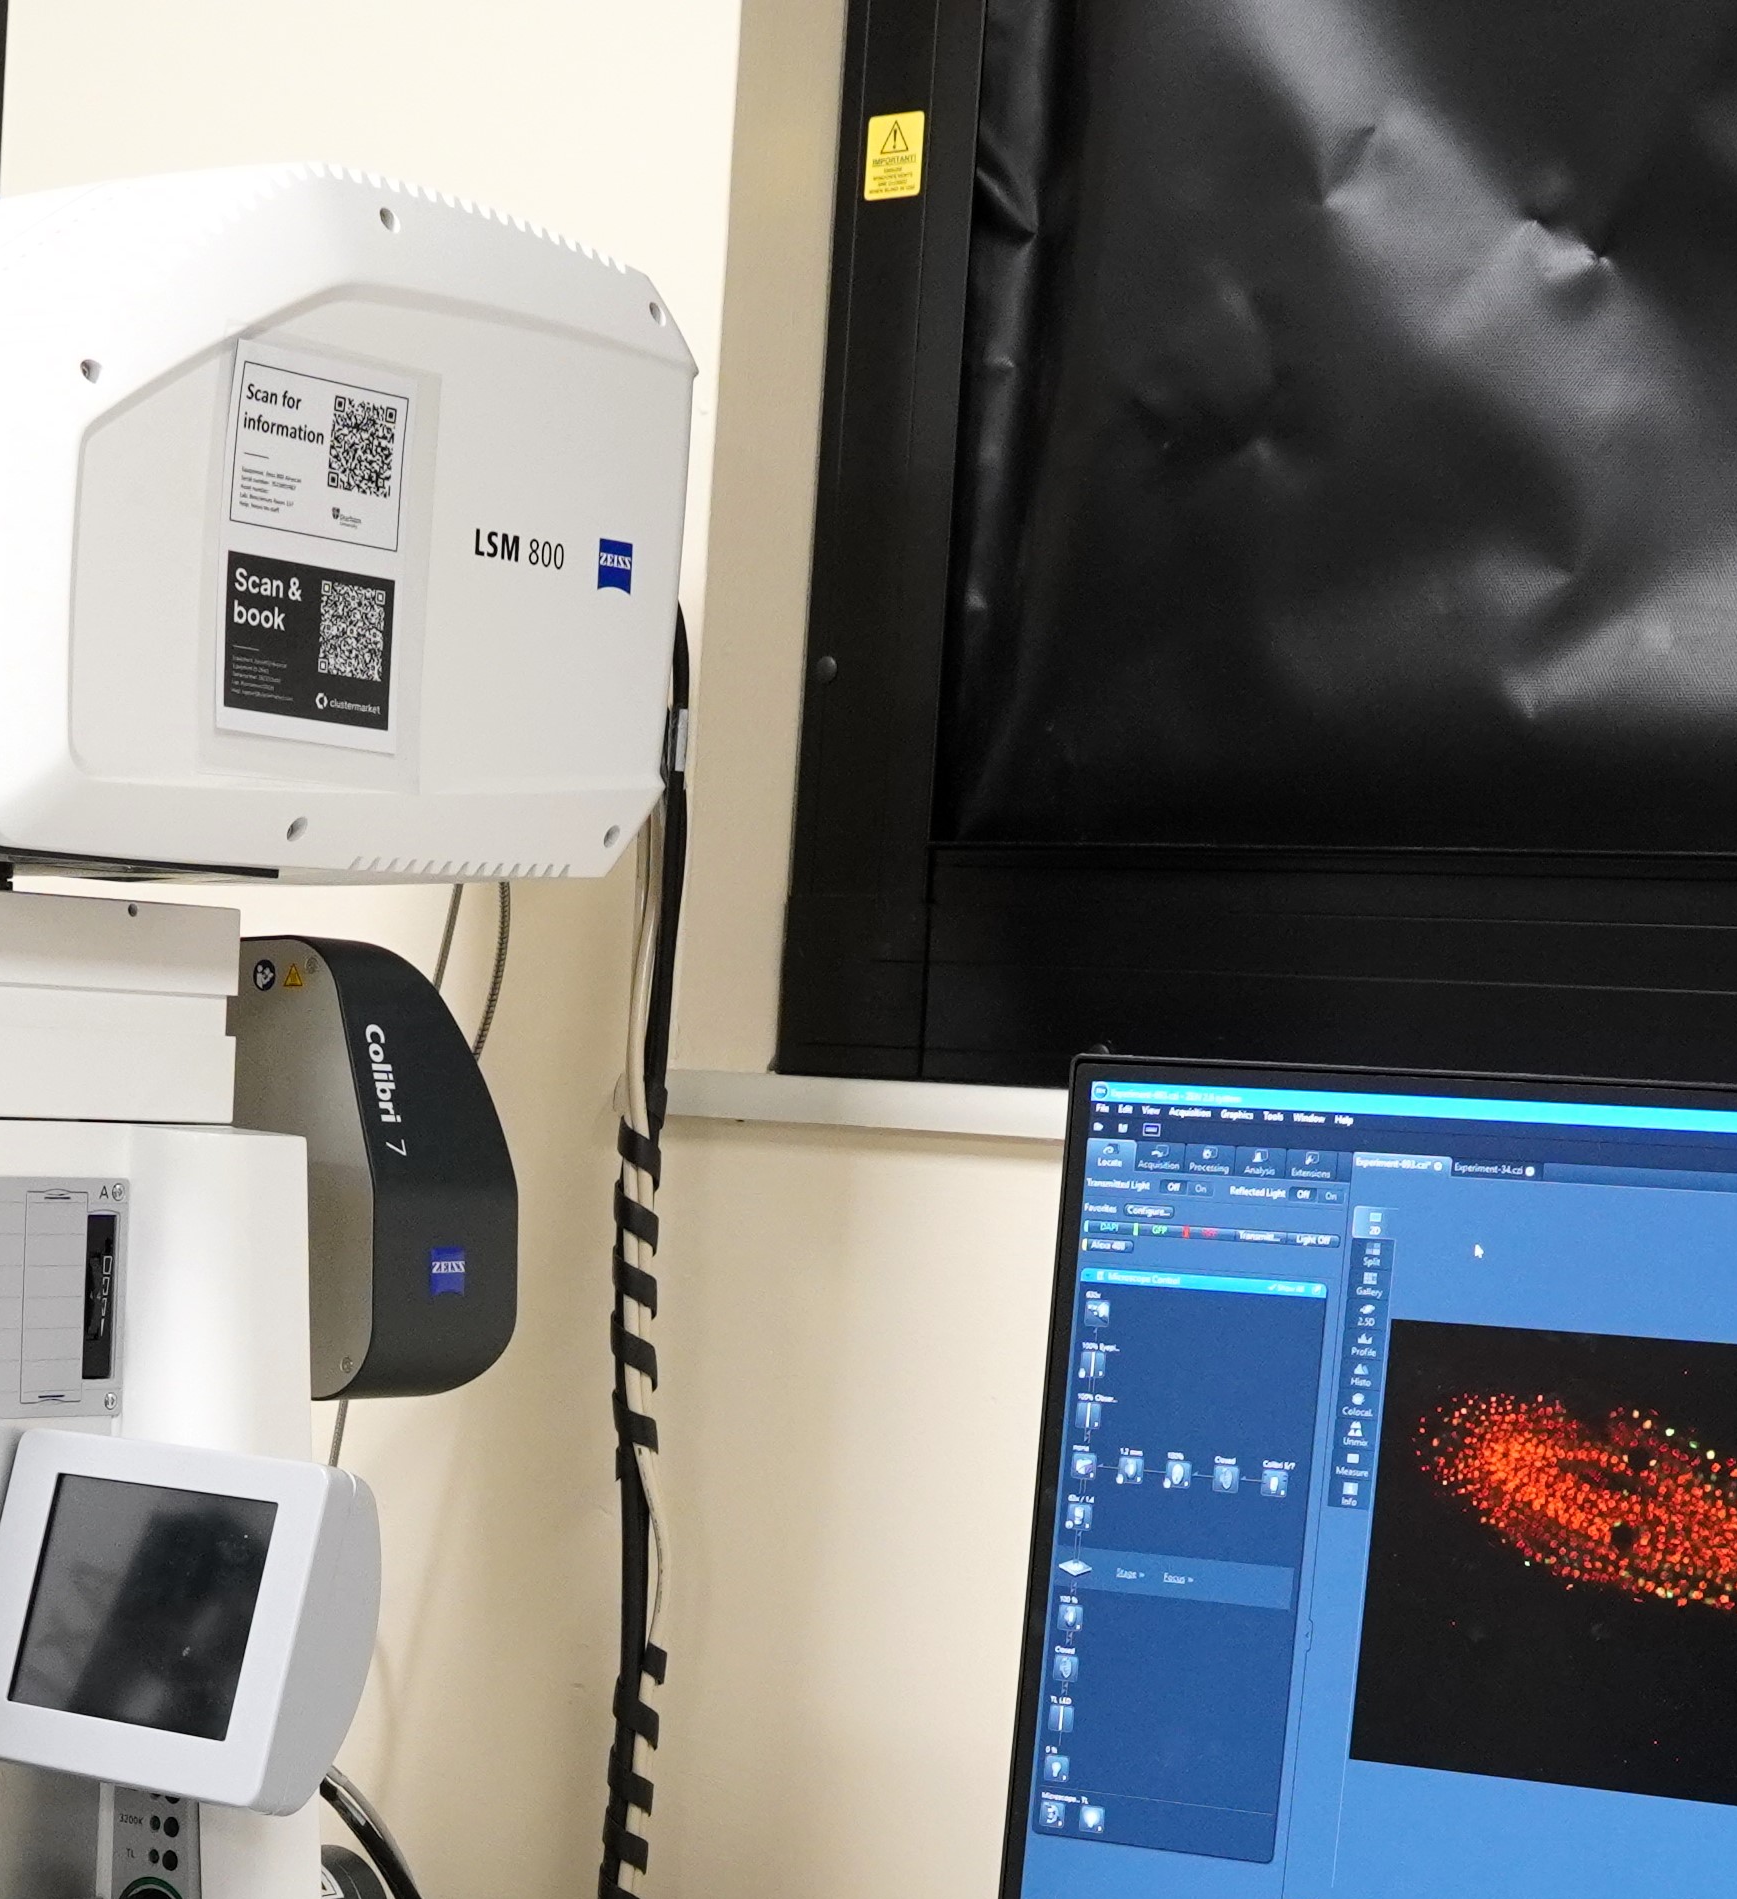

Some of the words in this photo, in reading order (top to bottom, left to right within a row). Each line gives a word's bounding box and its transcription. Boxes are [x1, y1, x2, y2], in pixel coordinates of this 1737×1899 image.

[872, 154, 917, 166] IMPORTANT!
[246, 383, 277, 405] Scan
[282, 390, 301, 410] for
[244, 411, 324, 445] information
[475, 528, 520, 562] LSM
[529, 539, 564, 570] 800
[600, 552, 631, 570] ZEISS
[234, 567, 283, 598] Scan
[288, 577, 302, 601] &
[234, 599, 285, 631] book
[330, 699, 381, 715] clustermarket
[365, 1024, 402, 1123] Colibri
[386, 1139, 407, 1157] 7
[1095, 1103, 1110, 1113] File
[1118, 1104, 1133, 1115] Edit
[1141, 1105, 1161, 1116] View
[1168, 1106, 1212, 1119] Acquisition
[1221, 1108, 1254, 1121] Graphics
[1263, 1111, 1284, 1122] Tools
[1293, 1112, 1326, 1124] Window
[1334, 1114, 1354, 1126] Help
[1097, 1157, 1123, 1168] Locate
[1138, 1159, 1180, 1171] Acquisition
[1189, 1161, 1230, 1175] Processing
[1244, 1165, 1275, 1177] Analysis
[1291, 1167, 1331, 1179] Extensions
[1086, 1178, 1130, 1190] Transmitted
[1131, 1180, 1150, 1192] Light
[1167, 1182, 1180, 1192] Off
[1194, 1184, 1207, 1194] On
[99, 1186, 109, 1199] A
[1230, 1185, 1261, 1197] Reflected
[1263, 1188, 1286, 1199] Light
[1084, 1203, 1117, 1214] Favorites
[1369, 1225, 1382, 1235] 2D
[432, 1261, 465, 1273] ZEISS
[1363, 1257, 1381, 1268] Split
[1108, 1273, 1151, 1285] Microscope
[1152, 1275, 1181, 1286] Control
[1356, 1287, 1383, 1299] Gallery
[1351, 1347, 1376, 1357] Profile
[1350, 1377, 1372, 1387] Histo
[1343, 1437, 1368, 1447] Unmix
[1335, 1466, 1369, 1477] Measure
[1341, 1497, 1357, 1506] Info
[1163, 1572, 1186, 1584] Focus
[119, 1814, 144, 1826] 3200K
[126, 1848, 135, 1858] TL
